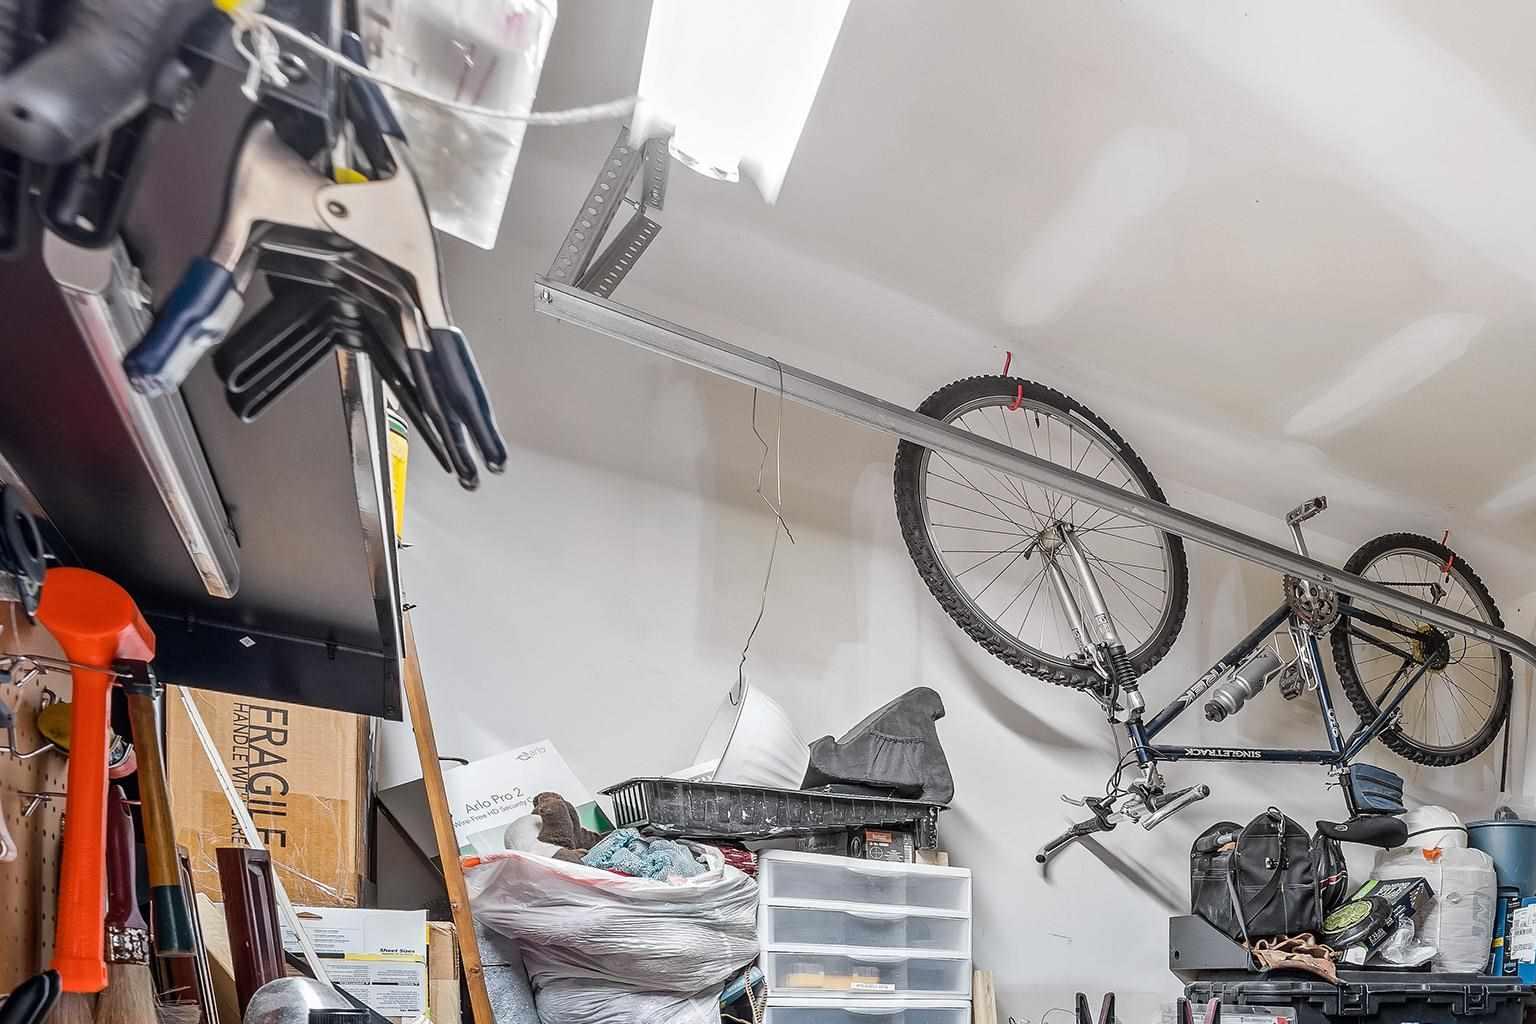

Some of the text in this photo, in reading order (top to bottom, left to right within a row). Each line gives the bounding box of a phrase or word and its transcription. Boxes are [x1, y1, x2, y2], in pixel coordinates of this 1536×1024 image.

[1177, 661, 1231, 709] TREK
[232, 702, 249, 762] HANDLE
[1184, 747, 1262, 759] SINGLETRACK
[248, 704, 290, 848] FRAGILE
[465, 800, 492, 814] Arlo
[490, 793, 514, 805] Pro
[513, 786, 524, 798] 2
